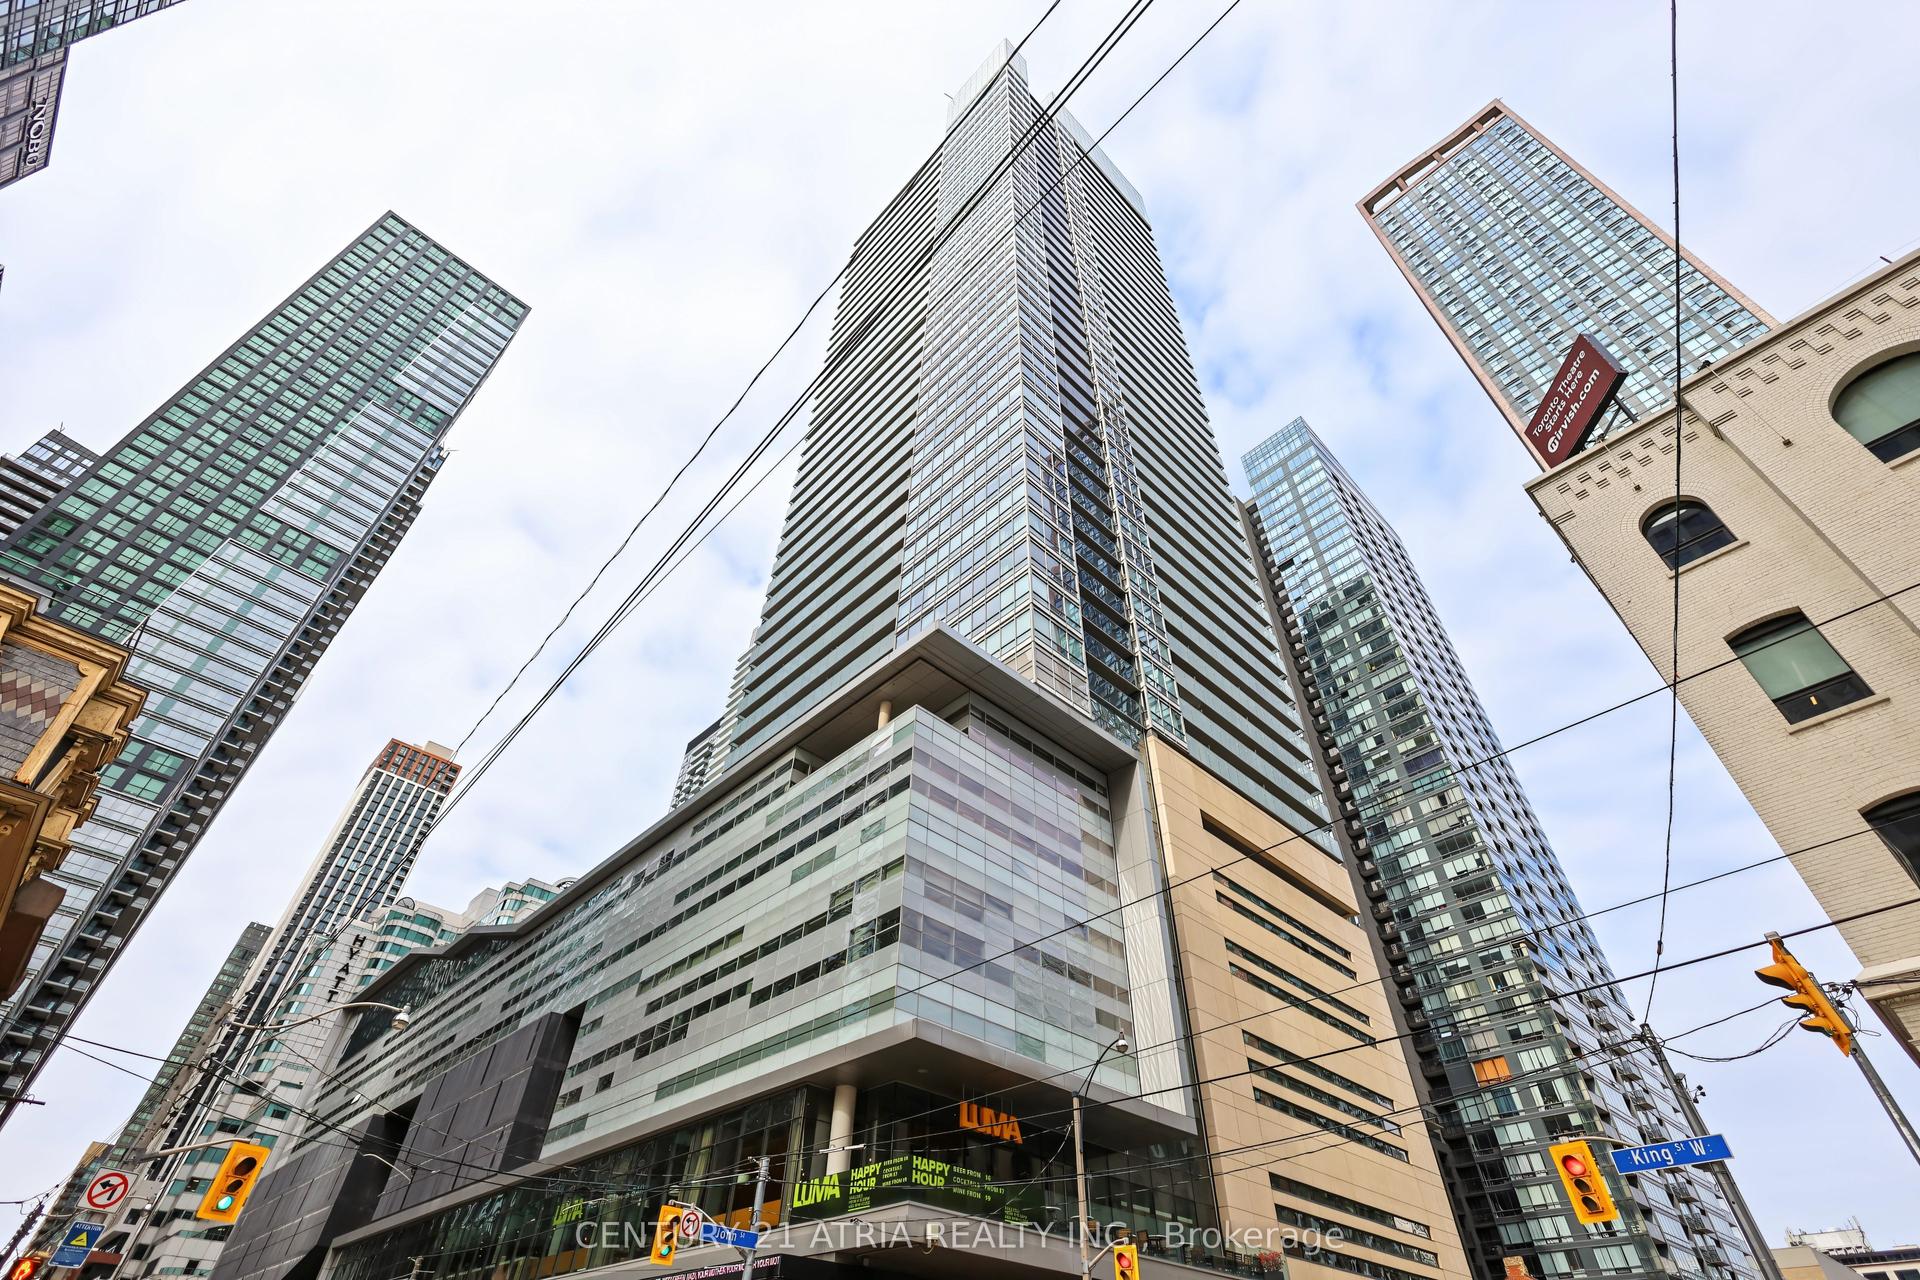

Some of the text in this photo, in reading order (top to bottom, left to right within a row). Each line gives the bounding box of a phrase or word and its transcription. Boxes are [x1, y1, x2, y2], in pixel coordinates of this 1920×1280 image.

[1532, 350, 1586, 437] Toronto Theatre
[1545, 370, 1583, 433] Starts Here
[327, 934, 367, 1003] HYATT
[960, 1100, 1023, 1144] LUMA
[1630, 1139, 1706, 1165] King St W
[851, 1162, 882, 1181] HAPPY
[913, 1155, 951, 1177] HAPPY
[966, 1169, 982, 1179] FROM
[849, 1176, 877, 1194] HOUR
[911, 1169, 945, 1187] HOUR
[792, 1173, 841, 1209] LUMA
[966, 1190, 982, 1199] FROM
[715, 1227, 745, 1242] John St
